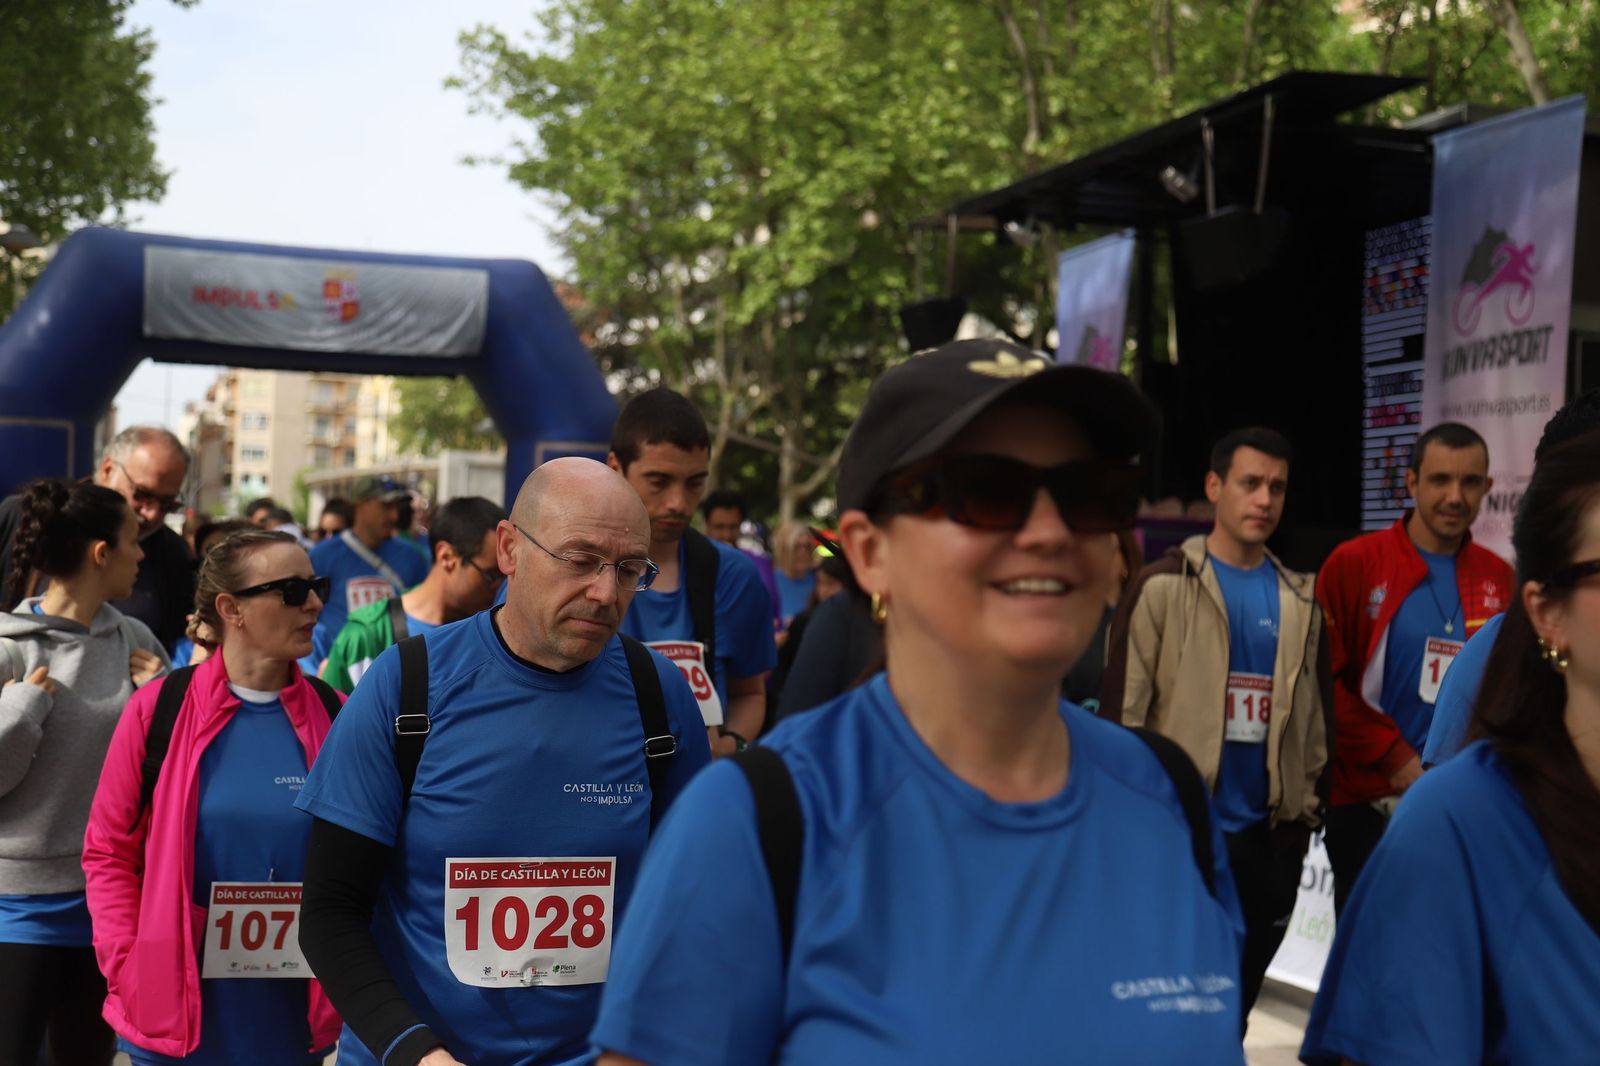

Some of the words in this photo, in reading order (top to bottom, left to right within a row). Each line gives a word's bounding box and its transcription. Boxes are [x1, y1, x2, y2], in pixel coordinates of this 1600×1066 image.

[563, 783, 613, 793] CASTILLA
[616, 783, 622, 794] Y
[624, 781, 644, 793] LEÓN
[455, 868, 478, 881] DÍA
[481, 869, 498, 880] DE
[500, 868, 559, 880] CASTILLA
[561, 868, 570, 879] Y
[572, 867, 606, 879] LEÓN
[216, 889, 234, 899] DÍA
[235, 891, 248, 899] DE
[249, 891, 290, 899] CASTILLA
[291, 891, 298, 899] Y
[455, 894, 606, 951] 1028
[215, 910, 296, 951] 107
